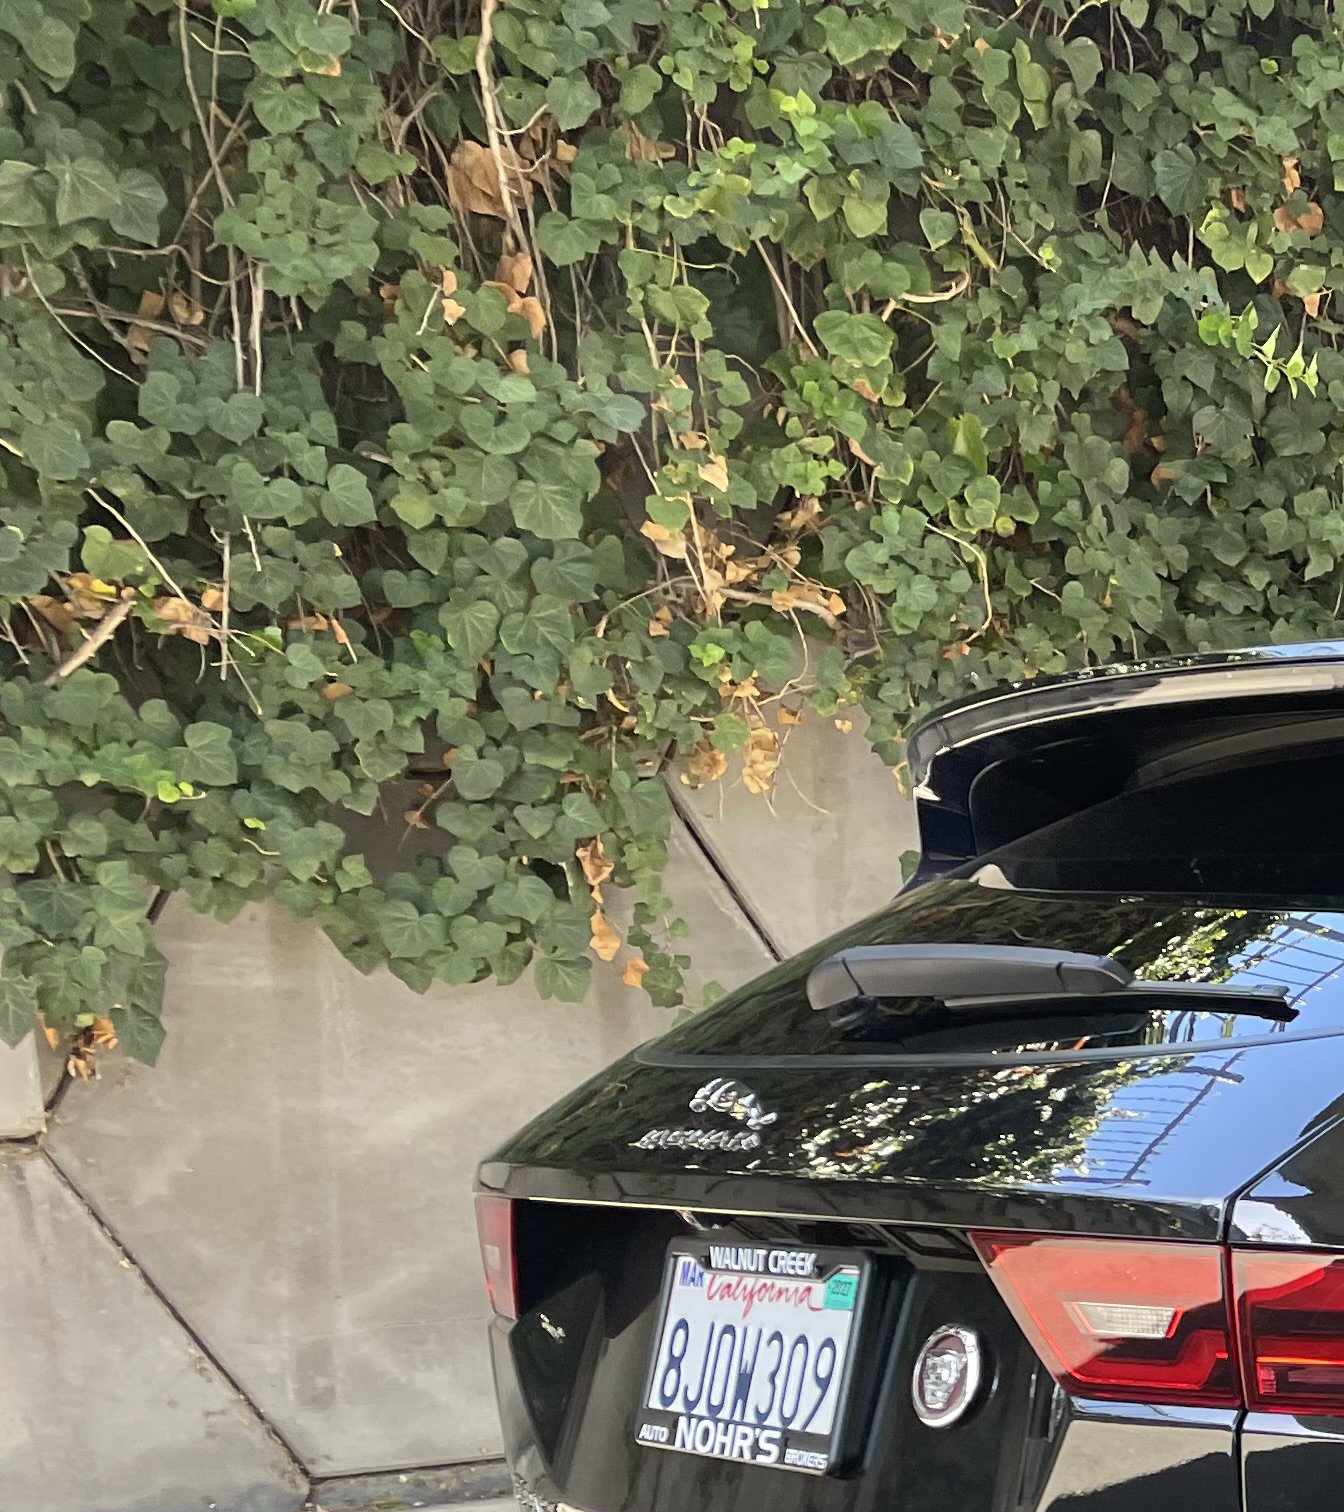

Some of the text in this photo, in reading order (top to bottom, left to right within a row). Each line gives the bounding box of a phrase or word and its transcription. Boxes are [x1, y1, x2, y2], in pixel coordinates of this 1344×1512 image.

[709, 1245, 818, 1276] WALNUT CREEK
[706, 1273, 824, 1319] California
[638, 1423, 669, 1443] AUTO
[674, 1415, 783, 1465] NOHR'S
